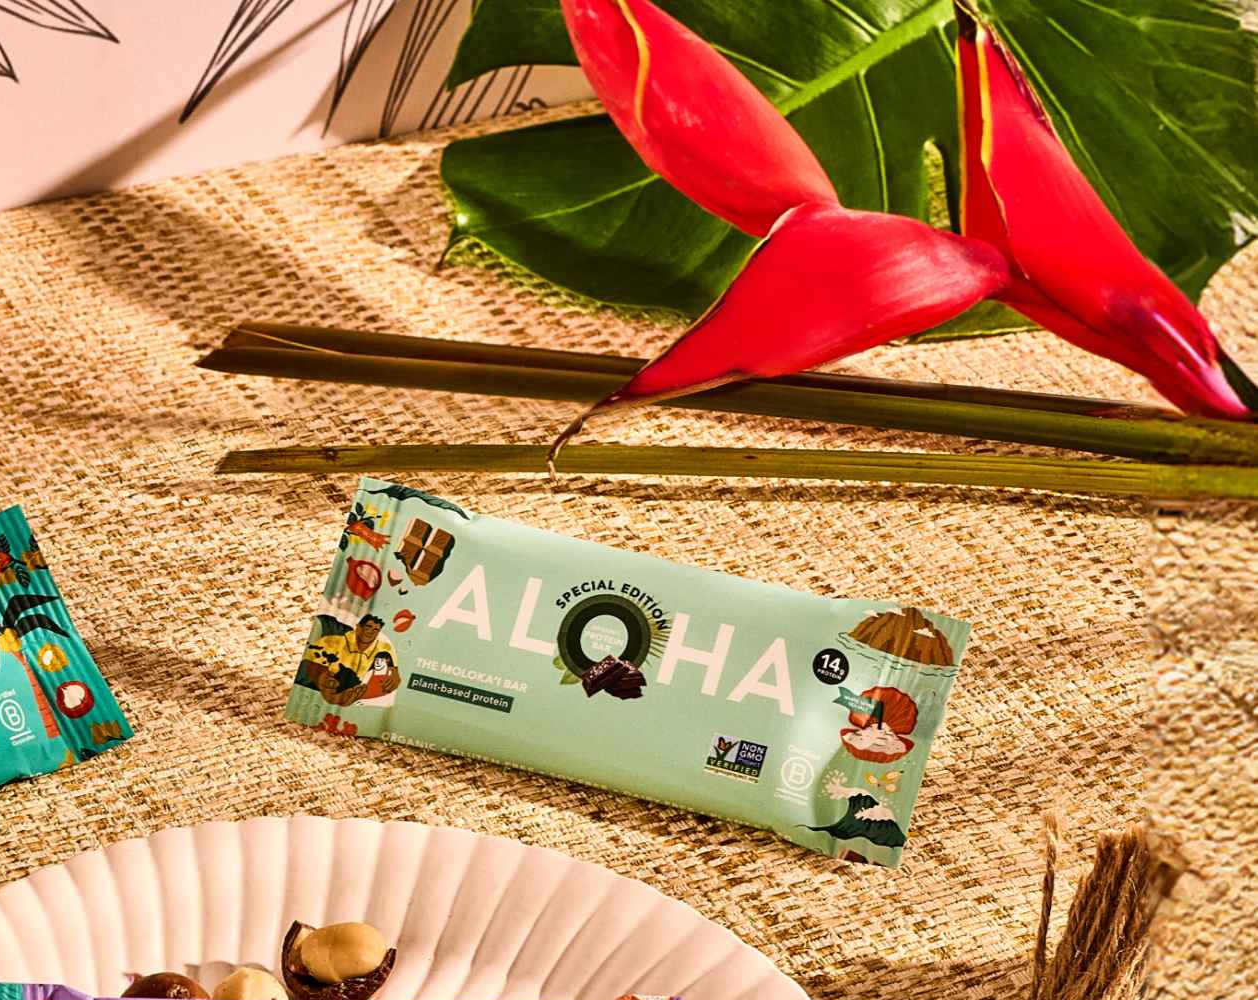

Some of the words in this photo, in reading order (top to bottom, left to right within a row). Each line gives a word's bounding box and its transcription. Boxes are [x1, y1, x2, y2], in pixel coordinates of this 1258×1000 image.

[556, 579, 615, 610] SPECIAL
[620, 583, 668, 631] EDITION
[428, 564, 796, 716] ALOHA
[416, 658, 439, 671] THE
[502, 679, 528, 693] BAR
[817, 668, 842, 680] PROTEIN
[411, 678, 471, 699] plant-based
[472, 690, 509, 708] protein
[4, 706, 21, 726] B
[739, 750, 763, 762] GMO
[742, 743, 765, 754] NON
[710, 759, 759, 776] VERIFIED
[789, 762, 807, 785] B
